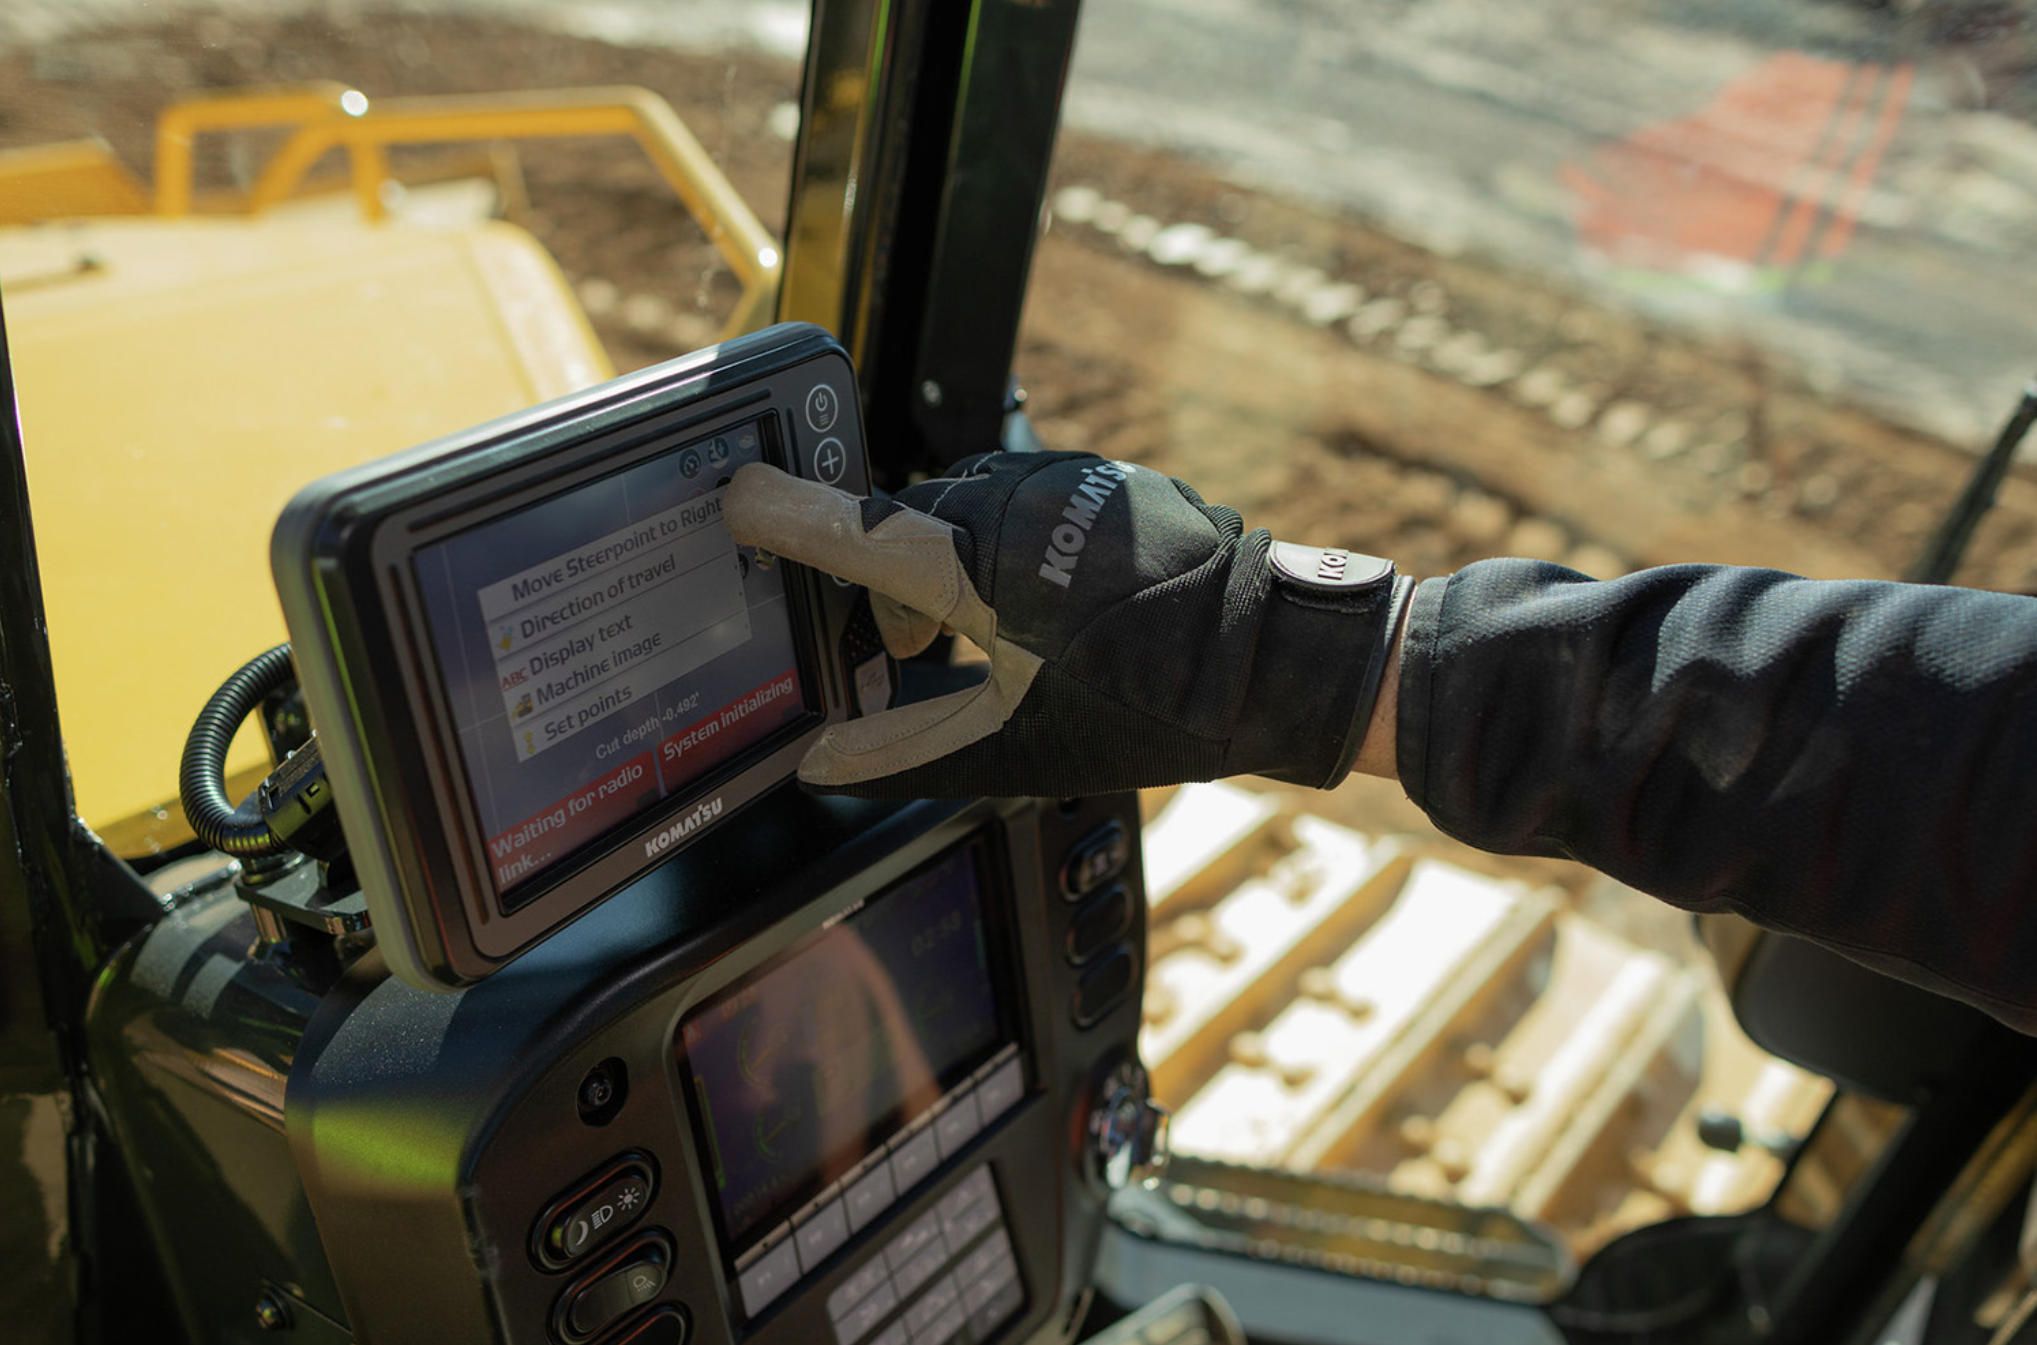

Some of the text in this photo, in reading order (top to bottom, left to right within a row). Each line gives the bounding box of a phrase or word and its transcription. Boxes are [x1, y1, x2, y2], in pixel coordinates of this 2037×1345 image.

[511, 498, 723, 601] Move Steerpoint to Right
[520, 554, 676, 639] Direction of travel
[529, 614, 633, 676] Display text
[536, 632, 662, 705] Machine image
[502, 667, 529, 690] ABC
[544, 686, 633, 741] Set points
[595, 737, 621, 760] Cut
[622, 716, 660, 745] depth
[663, 677, 794, 761] System initializing
[491, 764, 644, 858] Waiting for radio
[645, 797, 723, 858] KOMATSU
[497, 852, 551, 885] link...
